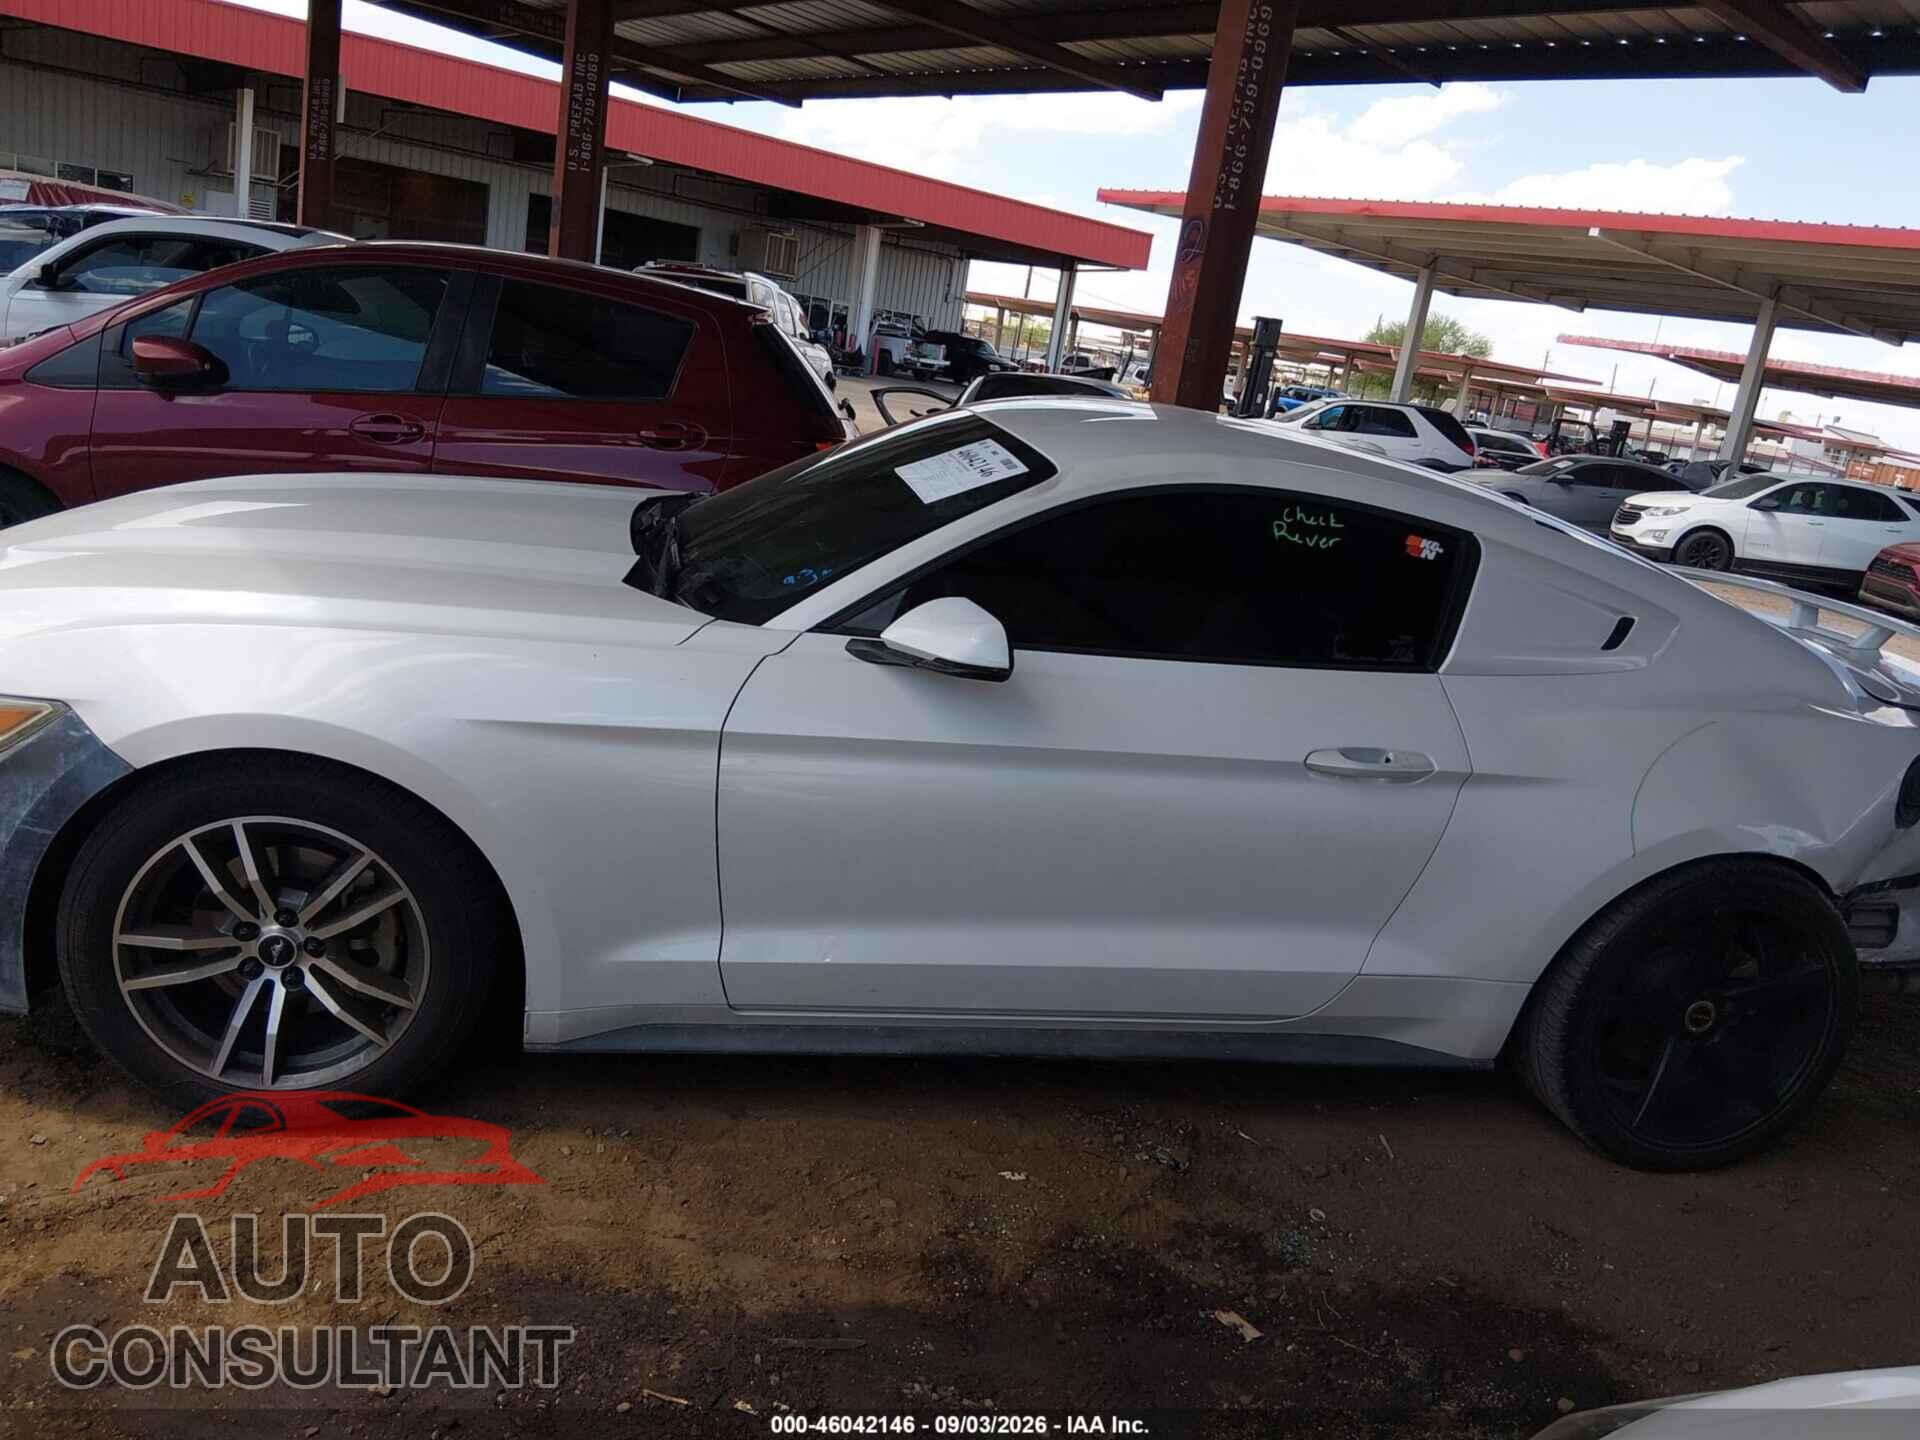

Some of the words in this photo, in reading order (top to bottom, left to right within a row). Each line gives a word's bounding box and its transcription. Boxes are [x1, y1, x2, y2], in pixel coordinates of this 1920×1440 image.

[570, 83, 584, 137] PREFAB
[1224, 6, 1272, 210] 1-866-799-0969
[1273, 520, 1343, 549] Rever
